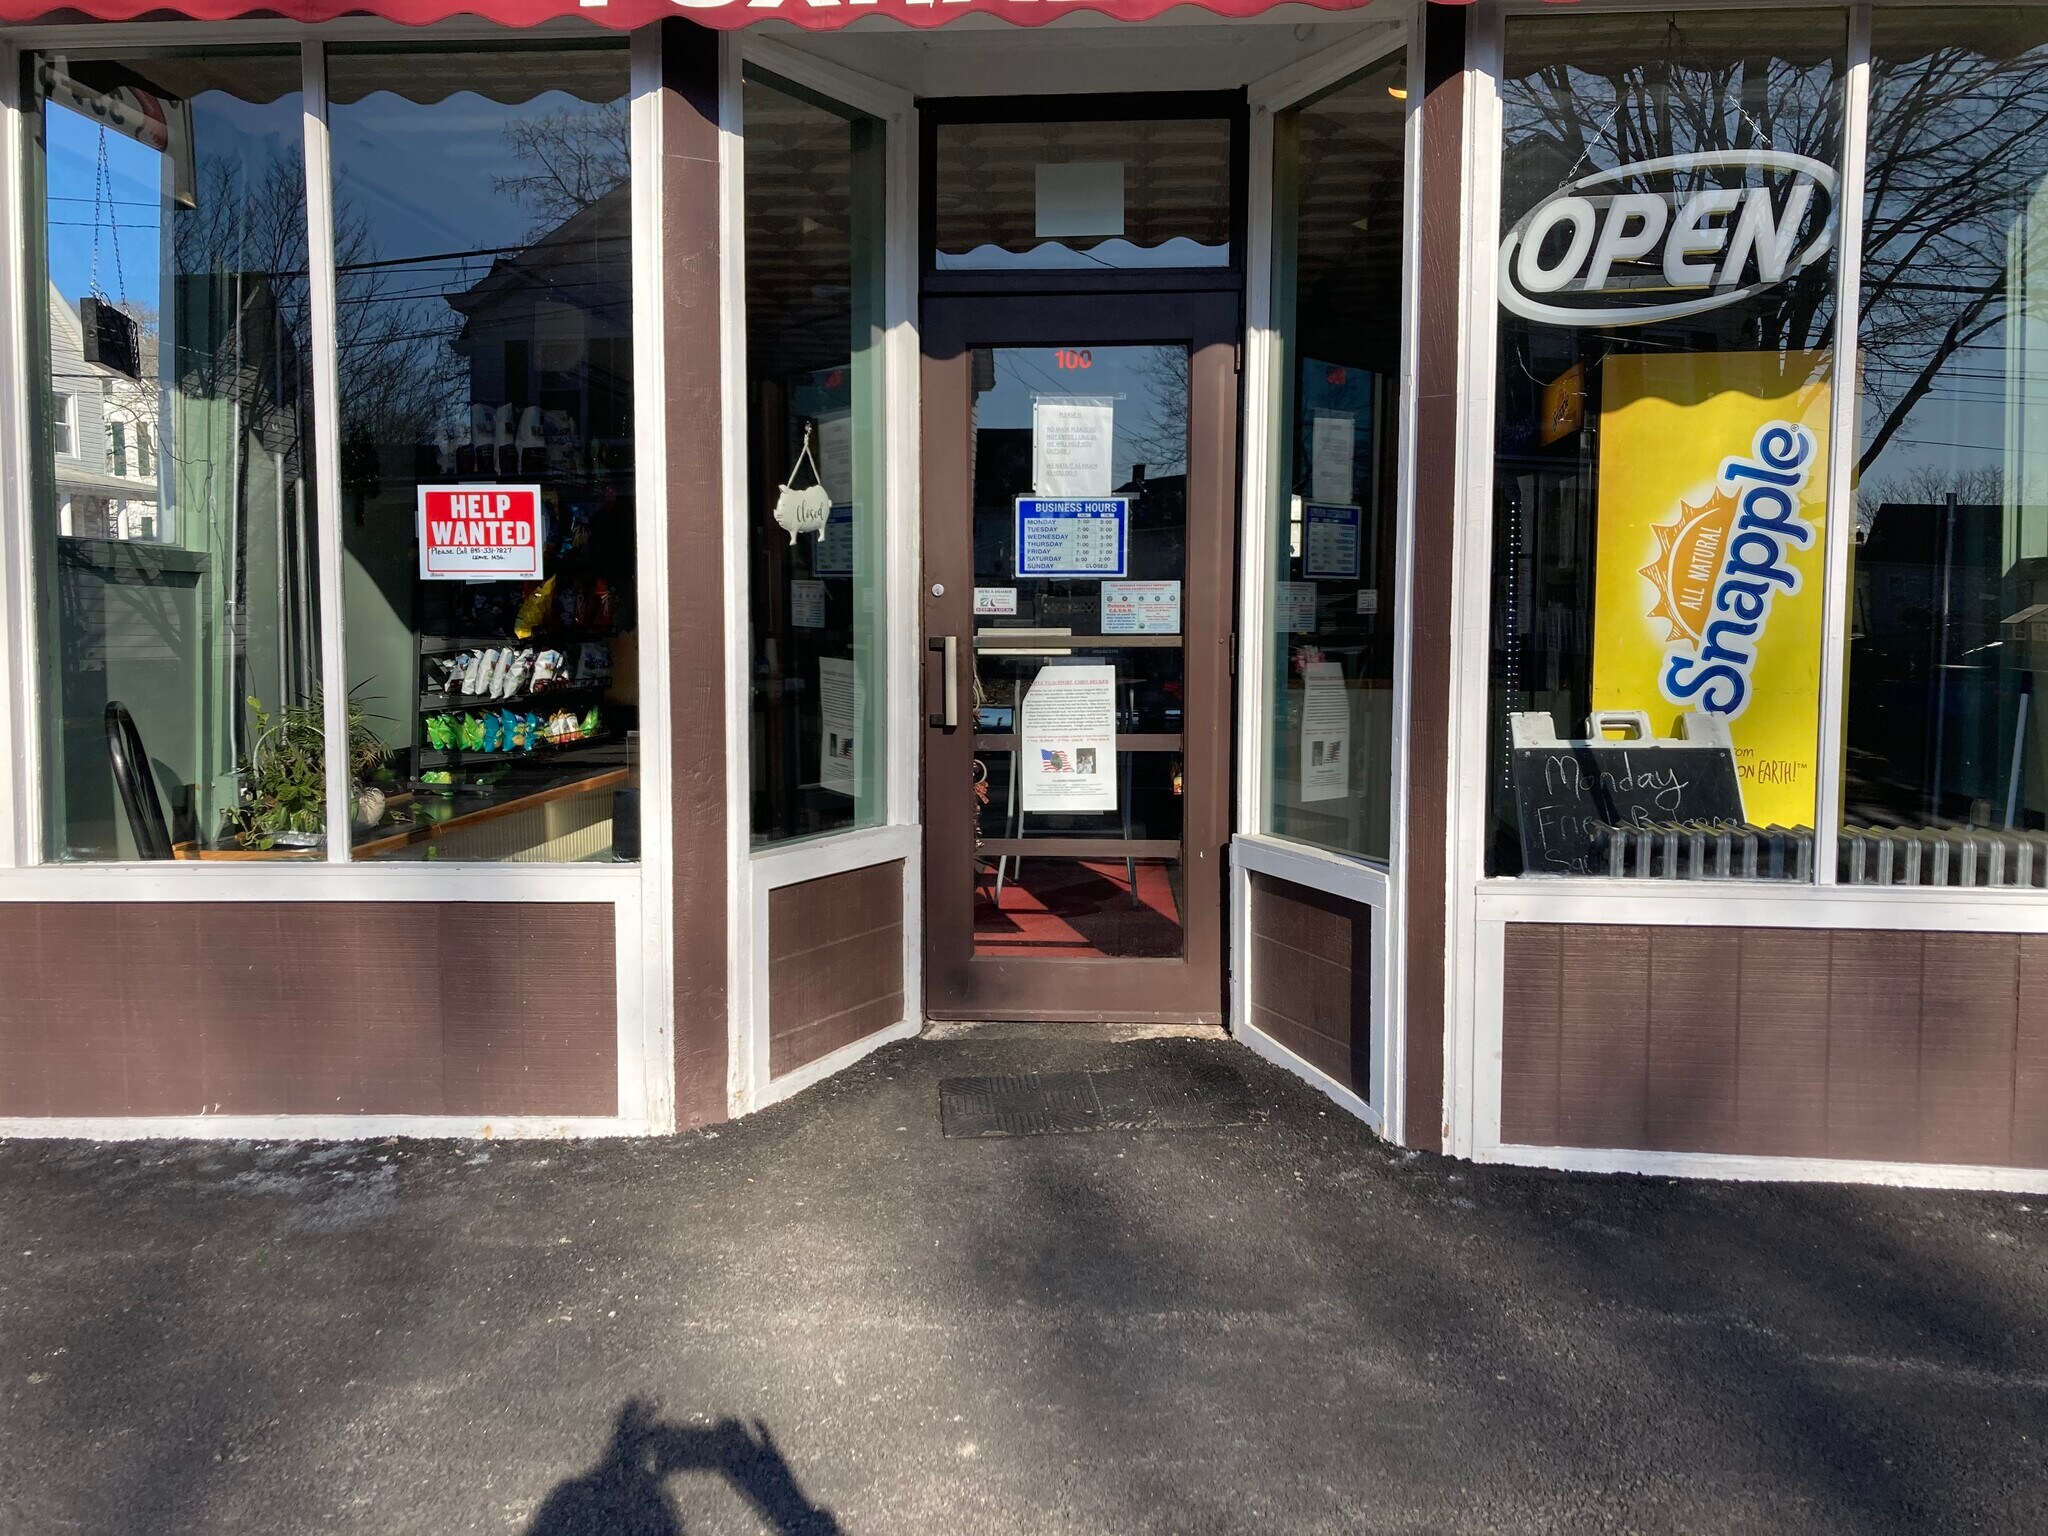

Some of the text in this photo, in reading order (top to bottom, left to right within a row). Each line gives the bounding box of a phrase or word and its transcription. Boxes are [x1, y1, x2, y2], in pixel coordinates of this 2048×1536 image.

[1517, 185, 1814, 293] OPEN
[1055, 350, 1092, 369] 100
[450, 494, 511, 519] HELP
[796, 499, 824, 523] Closed
[1035, 503, 1117, 512] BUSINESS HOURS
[431, 521, 531, 545] WANTED
[431, 546, 454, 555] Please
[456, 546, 468, 555] Call
[1666, 427, 1810, 716] Snapple
[1679, 525, 1723, 611] ALL NATURAL
[1545, 751, 1689, 812] Monday
[1738, 765, 1755, 778] ON
